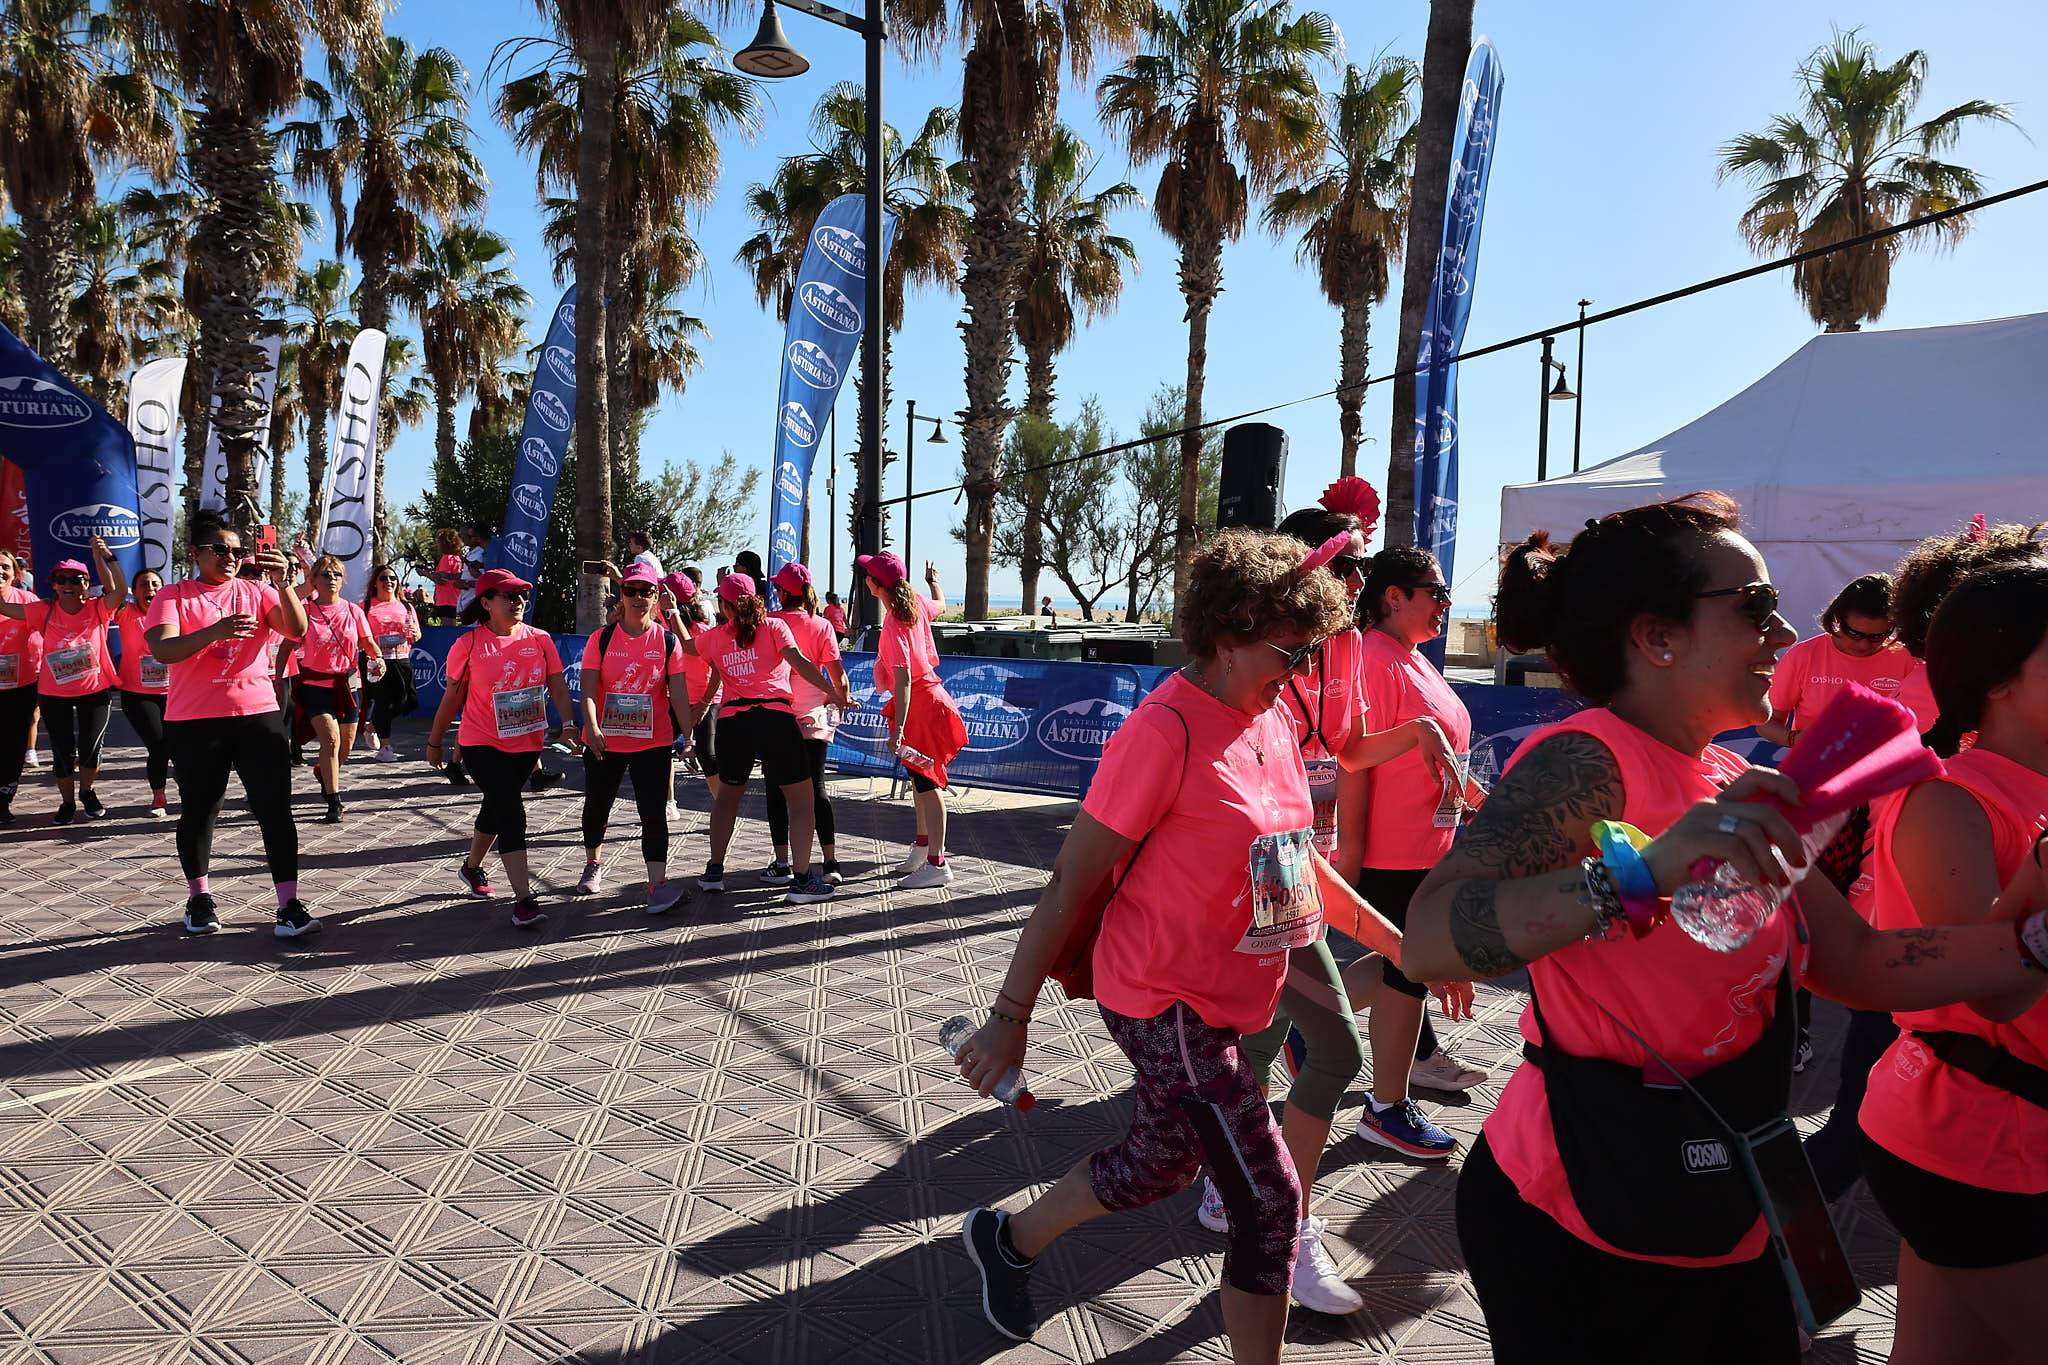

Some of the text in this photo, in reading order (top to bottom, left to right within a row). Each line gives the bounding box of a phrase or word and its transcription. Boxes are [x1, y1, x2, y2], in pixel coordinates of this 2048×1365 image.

[819, 232, 866, 271] ASTURIA
[803, 287, 855, 331] ASTURIANA
[548, 350, 577, 383] ASTURIAN
[792, 346, 832, 386] ASTURIANA
[0, 400, 86, 417] TURIANA
[535, 395, 567, 429] ASTURIANA
[322, 362, 372, 562] OYSHO
[136, 399, 170, 572] OYSHO
[57, 519, 140, 537] ASTURIANA
[722, 647, 759, 667] DORSAL
[727, 661, 755, 678] SUMA
[1811, 675, 1843, 684] OYSHO
[965, 721, 1020, 739] URIANA
[1044, 719, 1116, 745] ASTURI
[1686, 1142, 1728, 1168] COSMO
